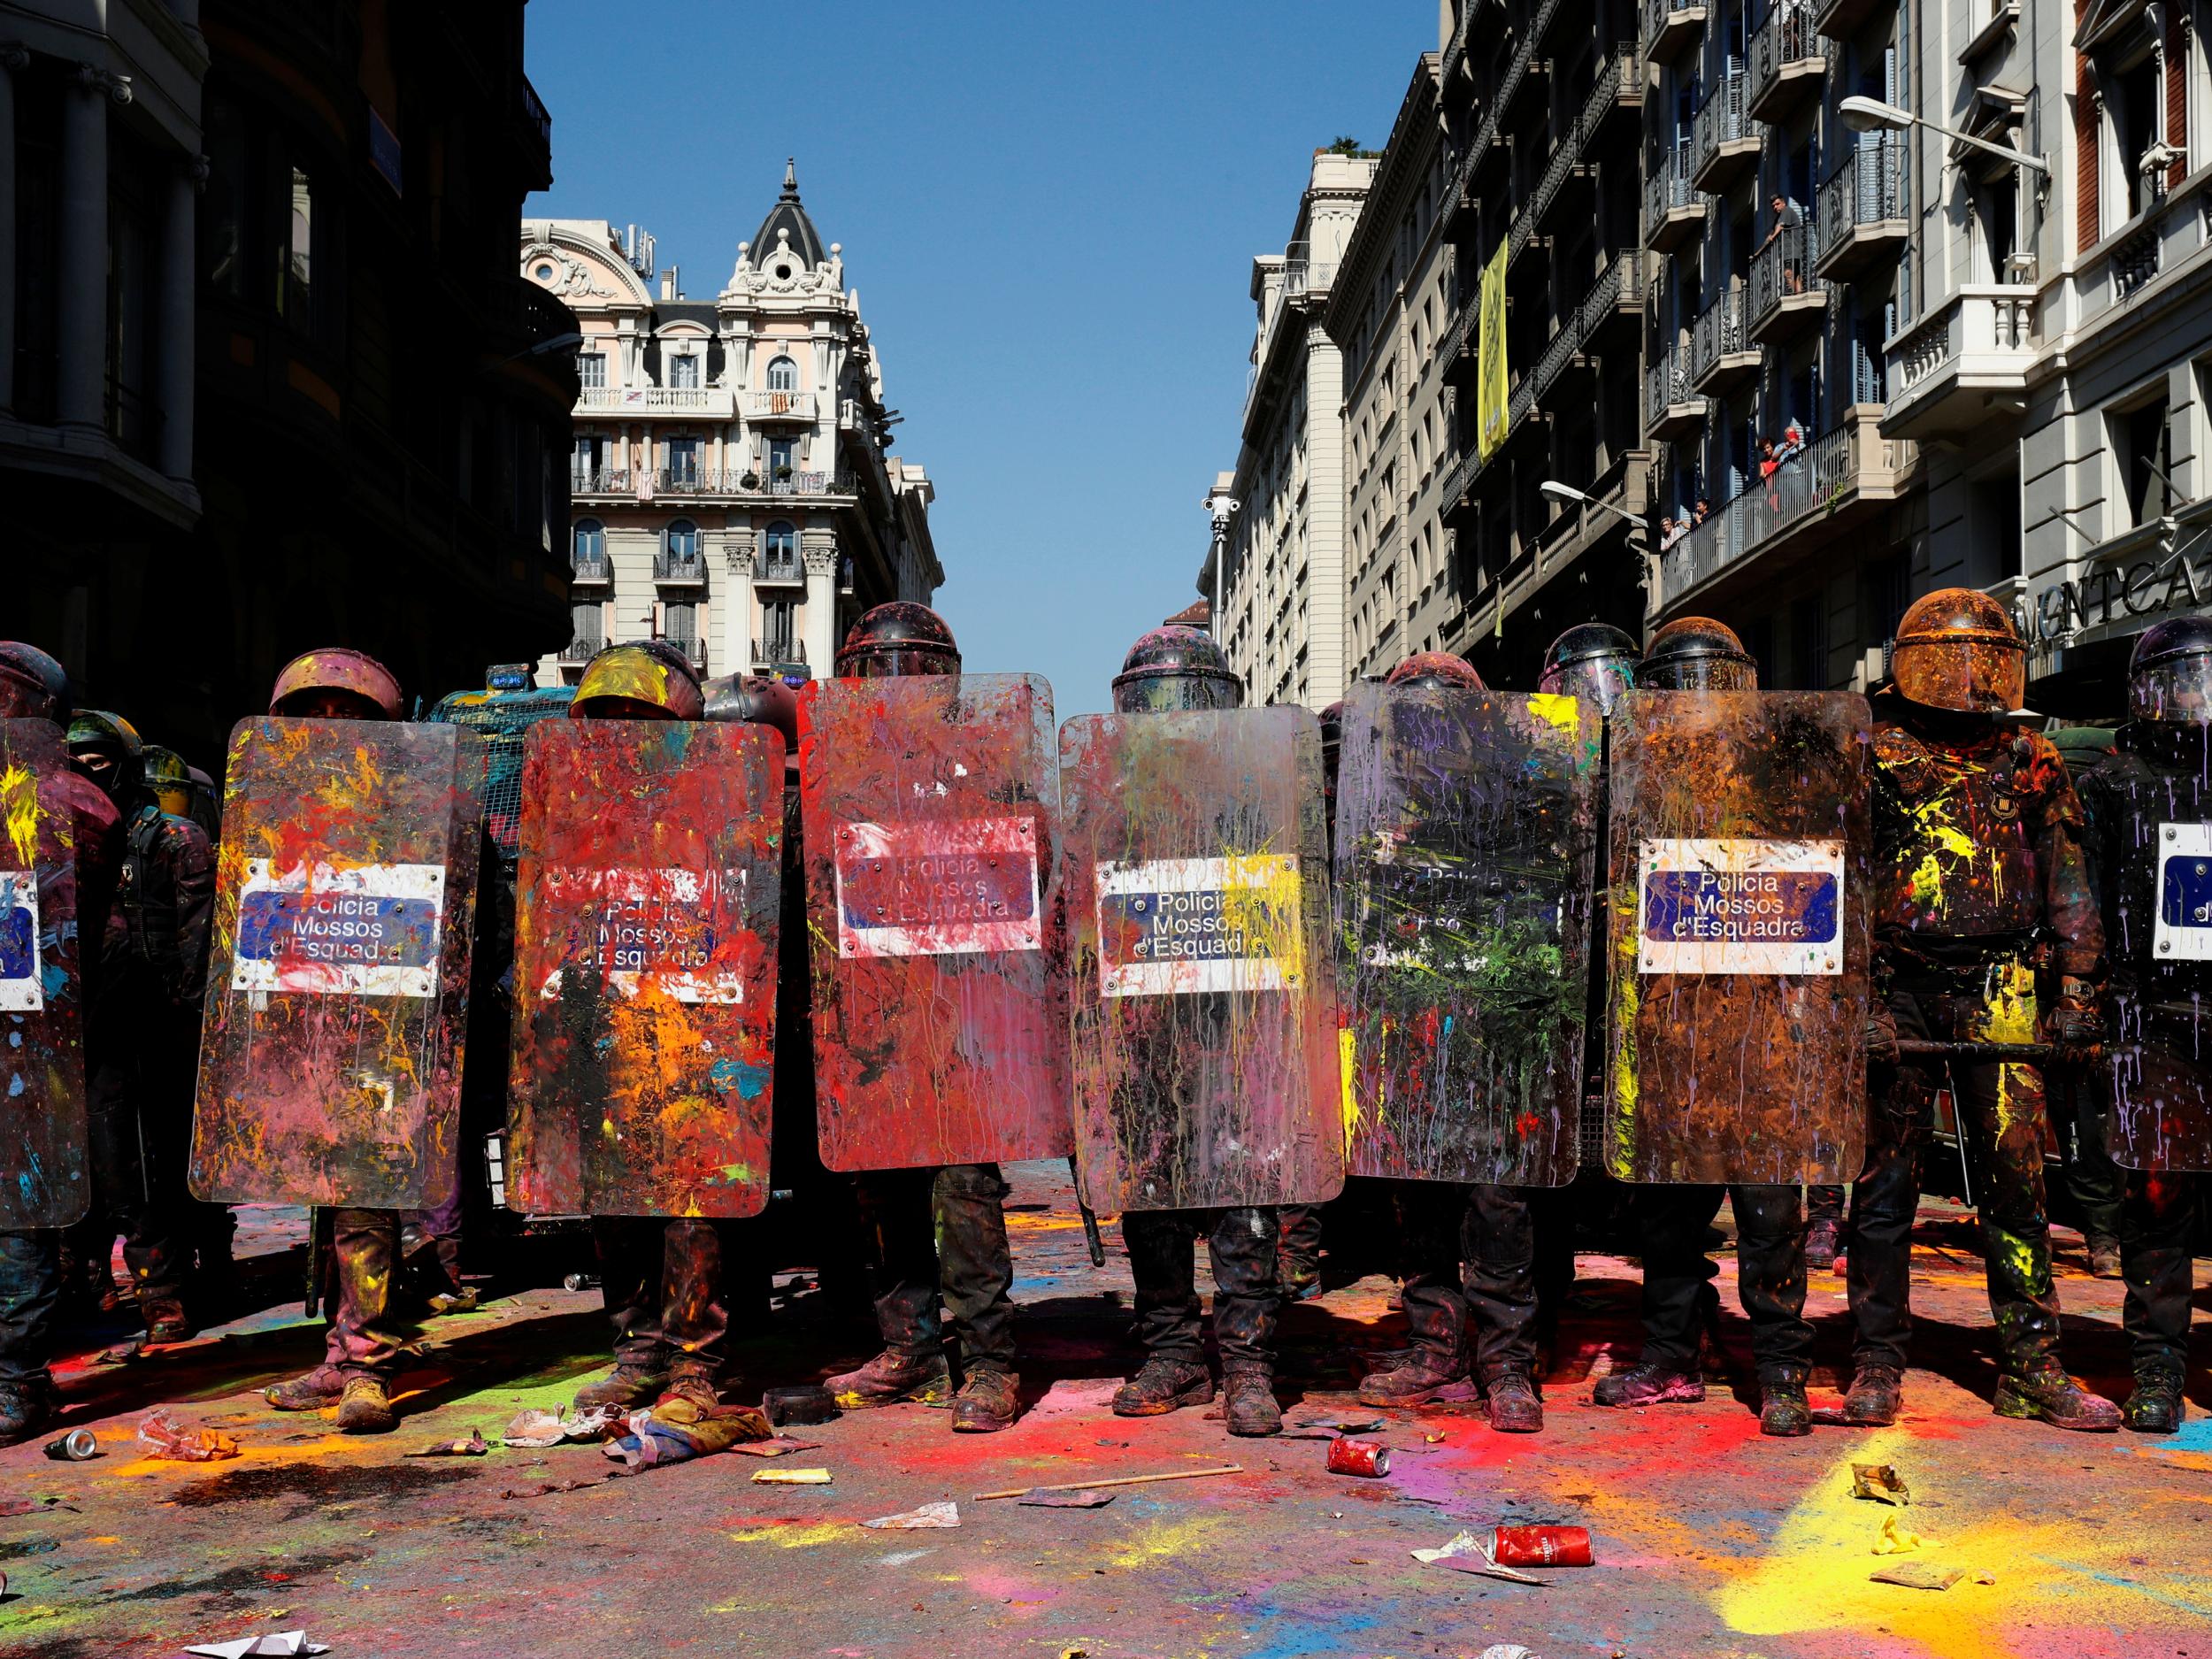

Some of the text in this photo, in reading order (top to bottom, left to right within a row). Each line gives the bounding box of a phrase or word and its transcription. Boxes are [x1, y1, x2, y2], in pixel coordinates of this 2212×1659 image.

[2016, 552, 2212, 645] MONTCA
[904, 858, 979, 877] olicia
[899, 880, 987, 898] Mssos
[1701, 872, 1778, 892] Policia
[606, 902, 683, 921] Polia
[1158, 891, 1234, 912] Policia
[1694, 895, 1784, 914] Mossos
[292, 916, 383, 938] Mossos
[1153, 915, 1243, 934] Mossos
[1672, 917, 1805, 941] d'Esquadra
[1133, 933, 1247, 959] d'Esquad
